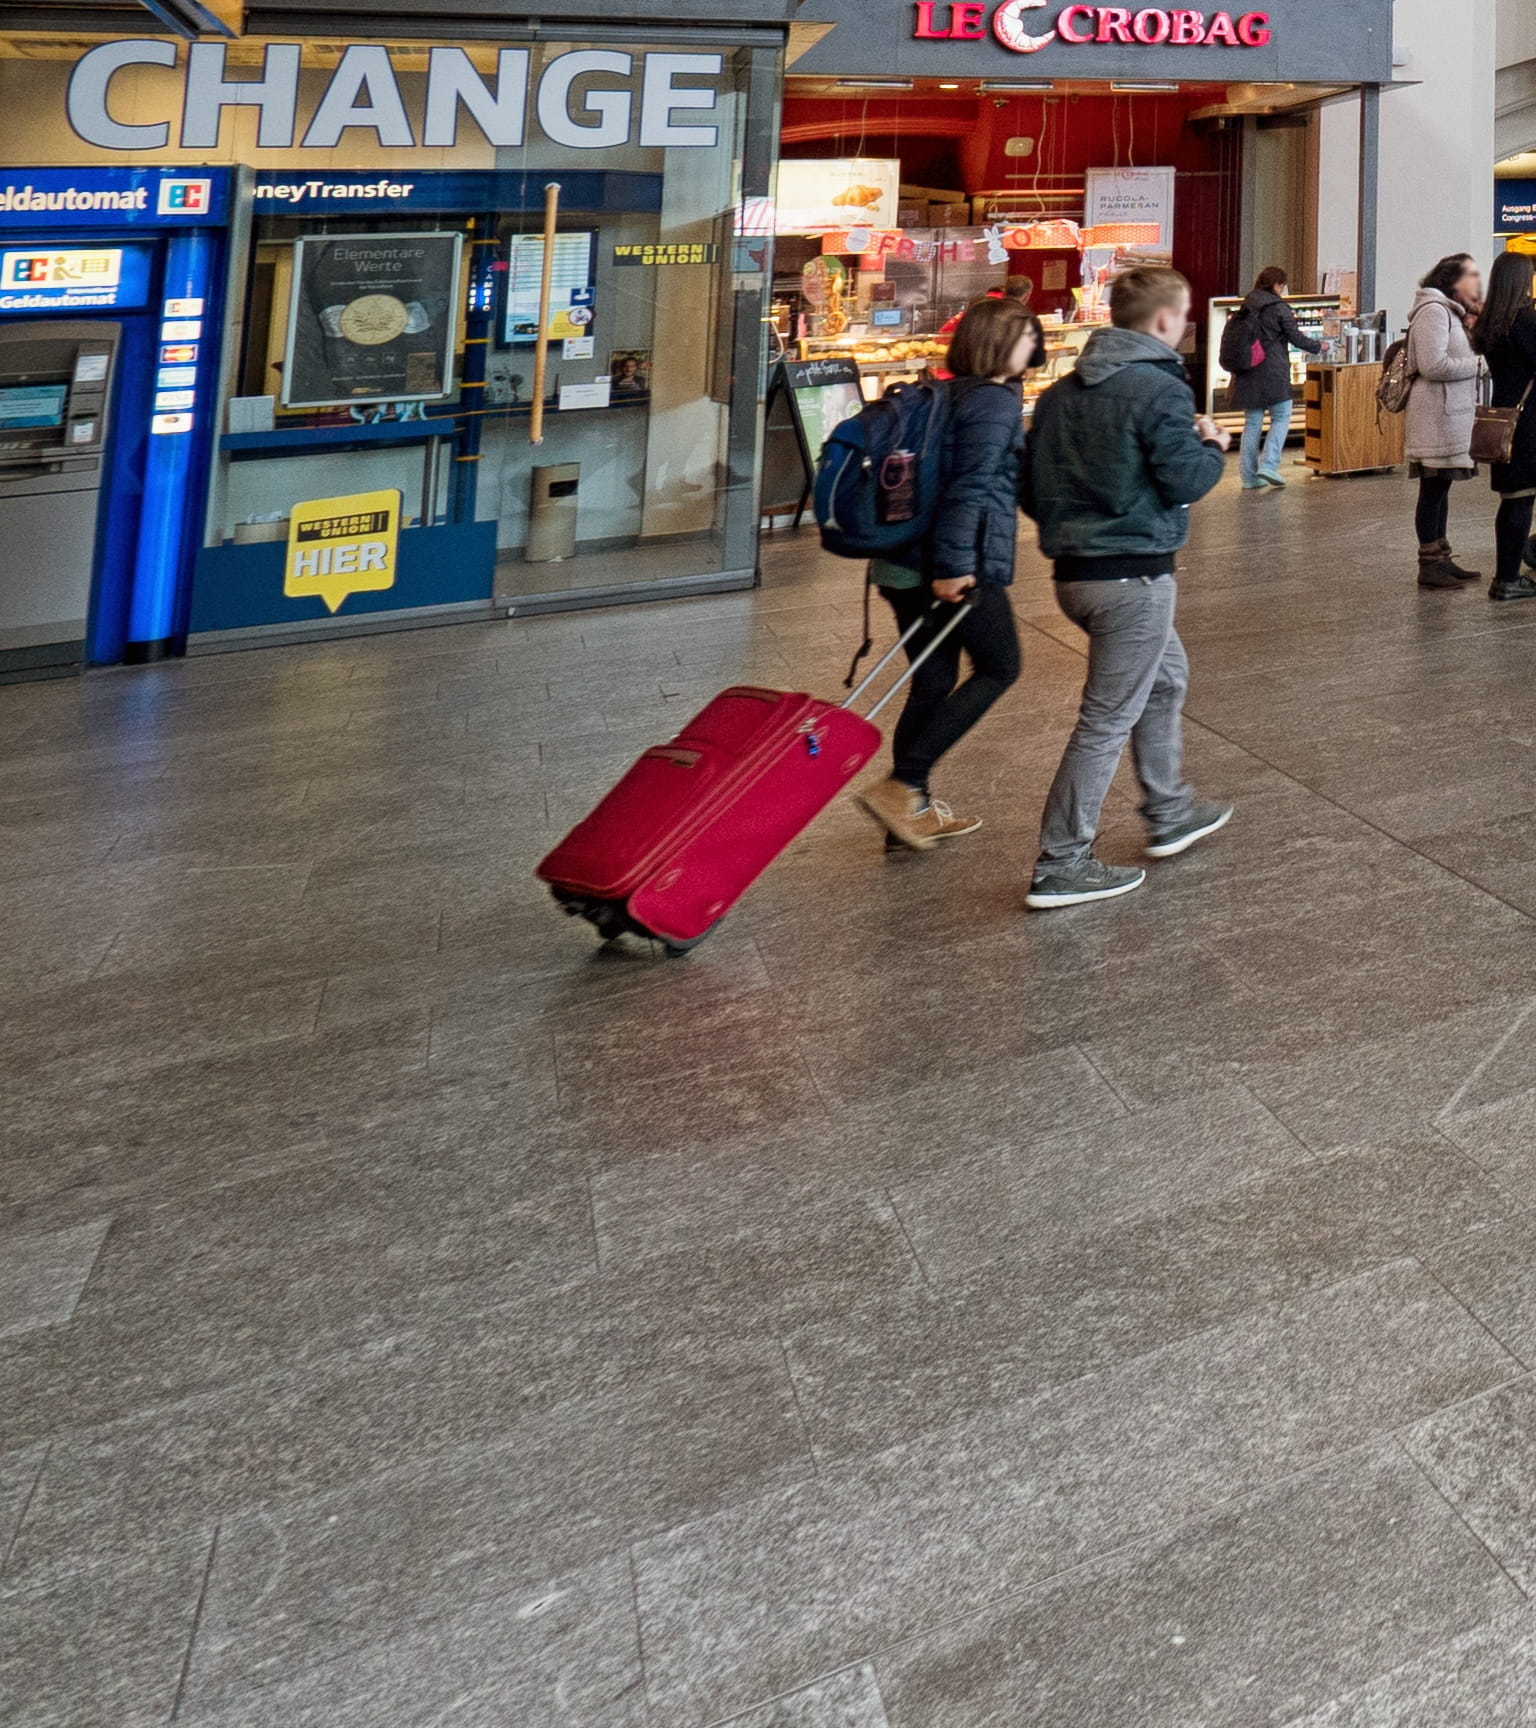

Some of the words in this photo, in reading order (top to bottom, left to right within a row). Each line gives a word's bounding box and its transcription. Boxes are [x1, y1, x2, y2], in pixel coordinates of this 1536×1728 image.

[913, 0, 985, 39] LE
[1056, 3, 1271, 48] CROBAG
[67, 39, 723, 150] CHANGE
[333, 248, 424, 261] Elementare
[615, 245, 703, 256] WESTERN
[878, 235, 976, 263] FROHE
[355, 260, 403, 273] Werte
[642, 253, 703, 264] UNION
[0, 293, 117, 309] Geldautomat
[300, 515, 371, 532] WESTERN
[321, 524, 371, 538] UNION
[293, 541, 387, 578] HIER
